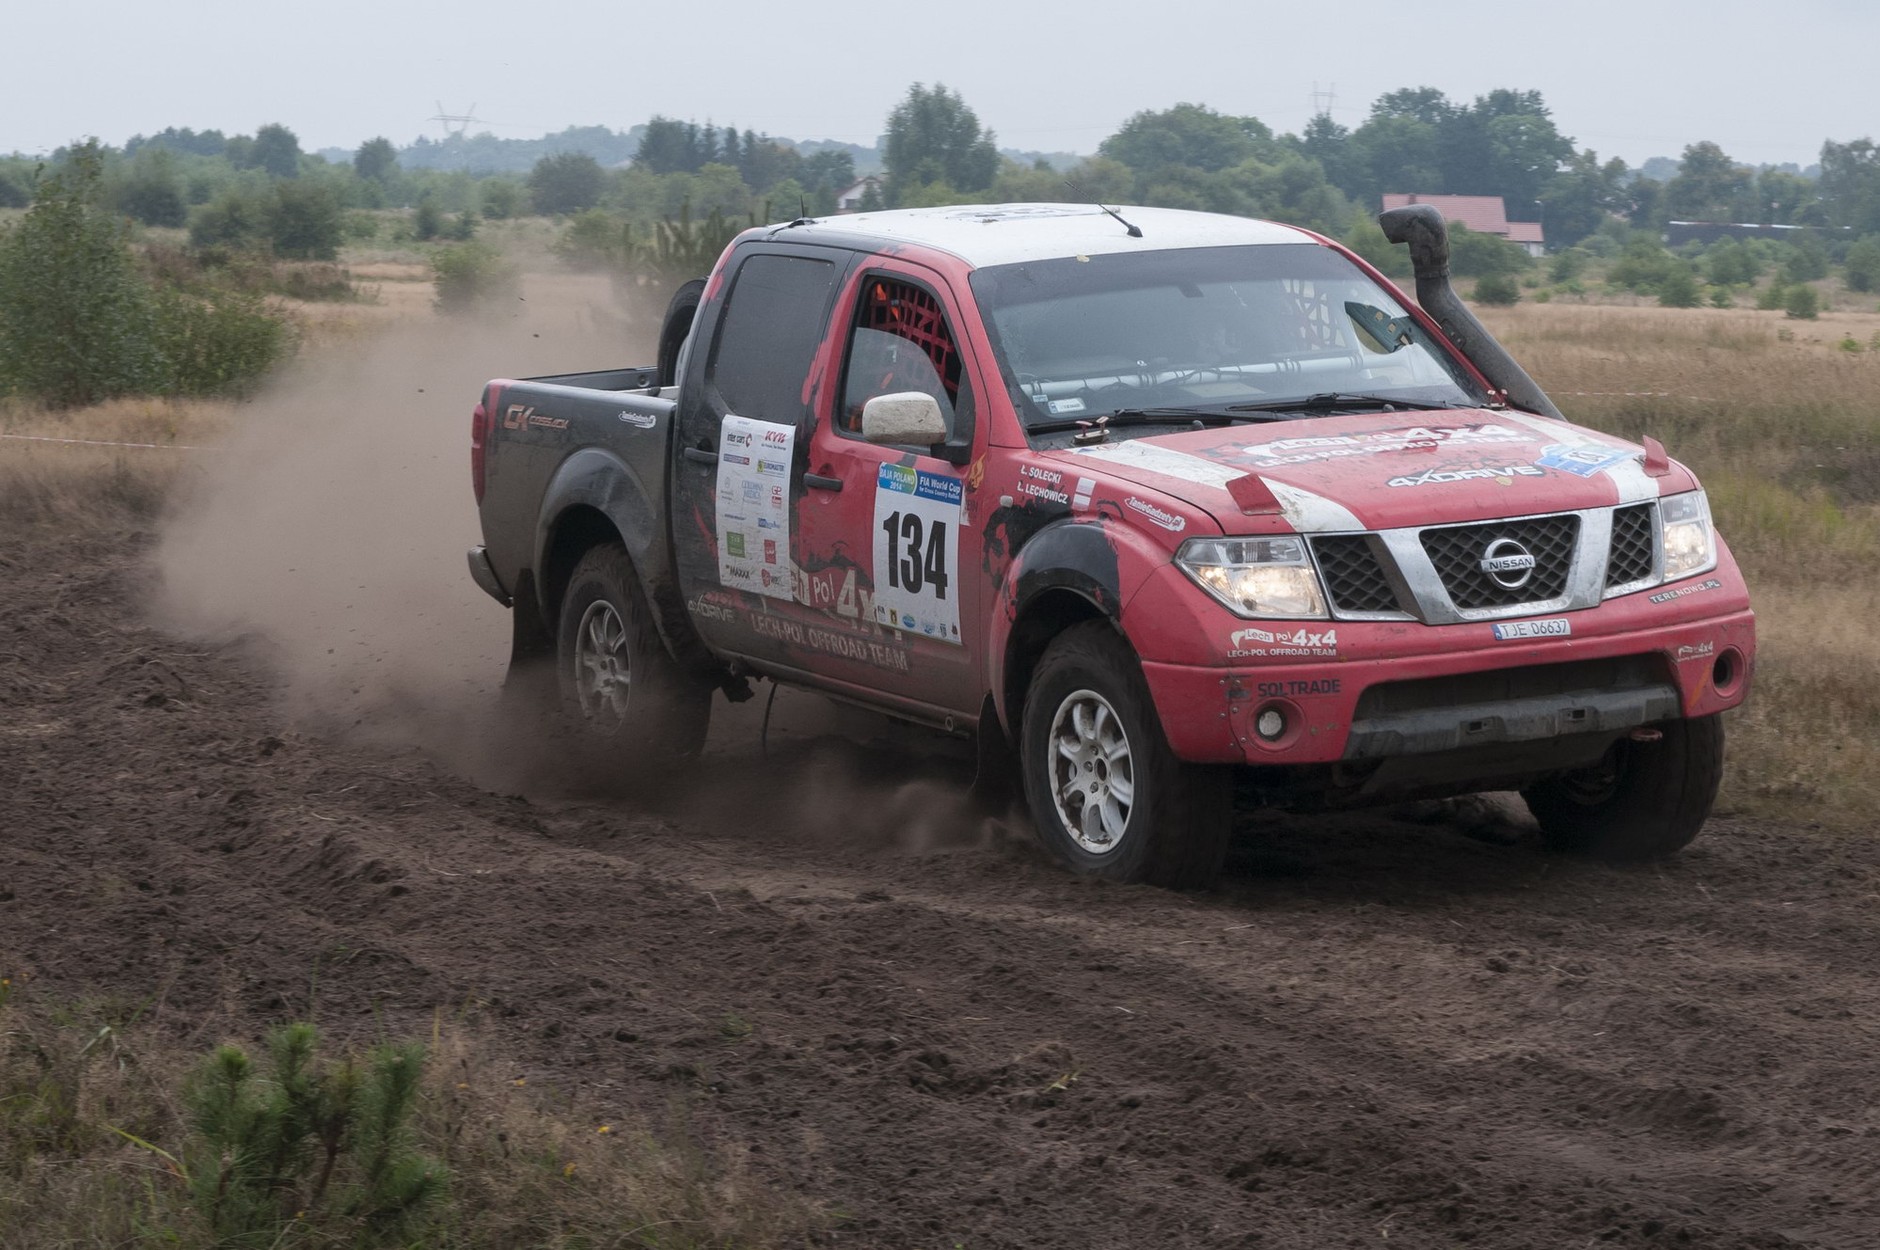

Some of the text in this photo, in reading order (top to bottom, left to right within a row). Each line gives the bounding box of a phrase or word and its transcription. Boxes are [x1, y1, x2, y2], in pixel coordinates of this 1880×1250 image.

[879, 468, 915, 485] BAJA POLAND
[1028, 466, 1062, 484] SOLECKI
[919, 476, 961, 495] FIA World Cup
[1025, 484, 1069, 505] LECHOWICZ
[882, 510, 948, 600] 134
[1489, 558, 1532, 570] NISSAN
[812, 573, 835, 604] Pol
[1649, 581, 1720, 603] TERENOWO.PL
[1246, 629, 1338, 646] Lech Pol 4x4
[1500, 620, 1567, 637] TJE 06637
[751, 613, 909, 671] LECH-POL OFFROAD TEAM
[1227, 648, 1337, 658] LECH-POL OFFROAD TEAM
[1257, 679, 1341, 697] SOLTRADE
